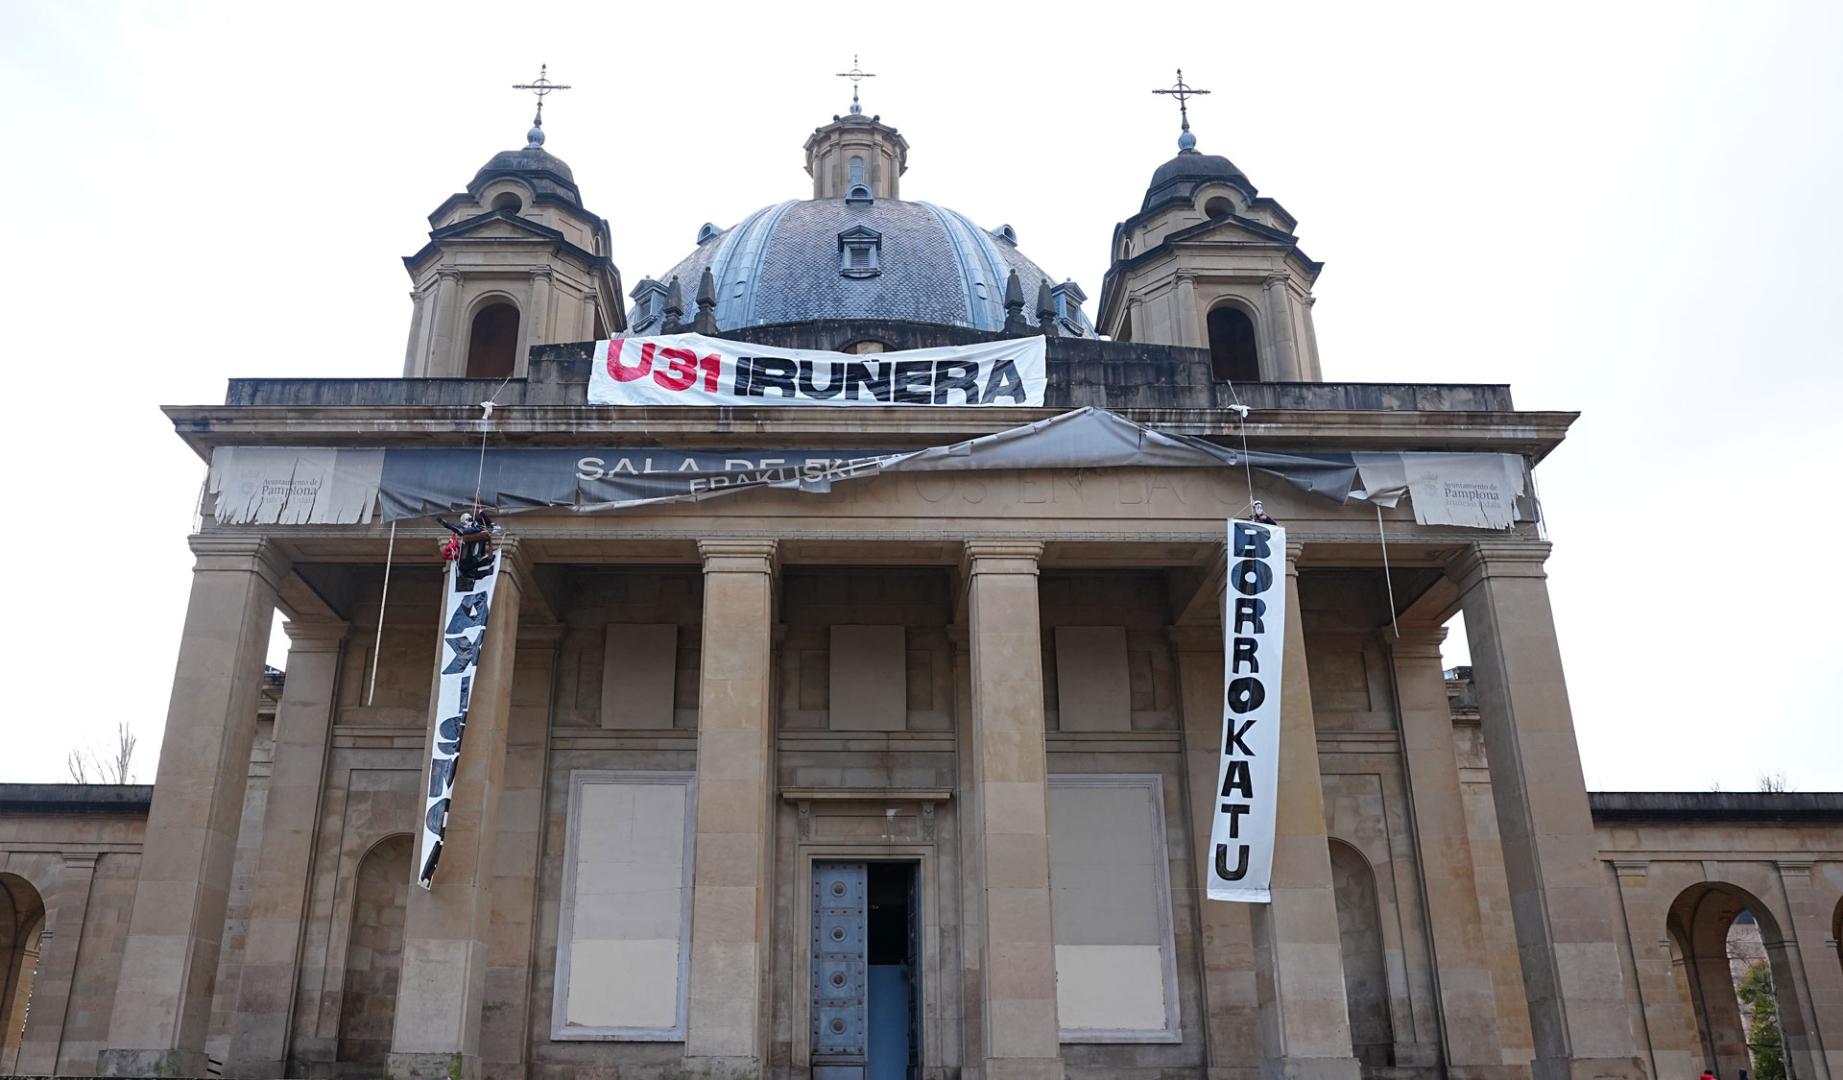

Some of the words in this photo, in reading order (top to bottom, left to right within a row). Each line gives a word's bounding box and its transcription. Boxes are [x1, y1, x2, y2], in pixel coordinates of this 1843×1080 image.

[605, 338, 721, 394] U31
[733, 356, 1028, 405] IRUÑERA
[261, 485, 317, 497] Pamplona
[1444, 487, 1499, 501] Pamplona
[1215, 522, 1273, 881] BORROKATU
